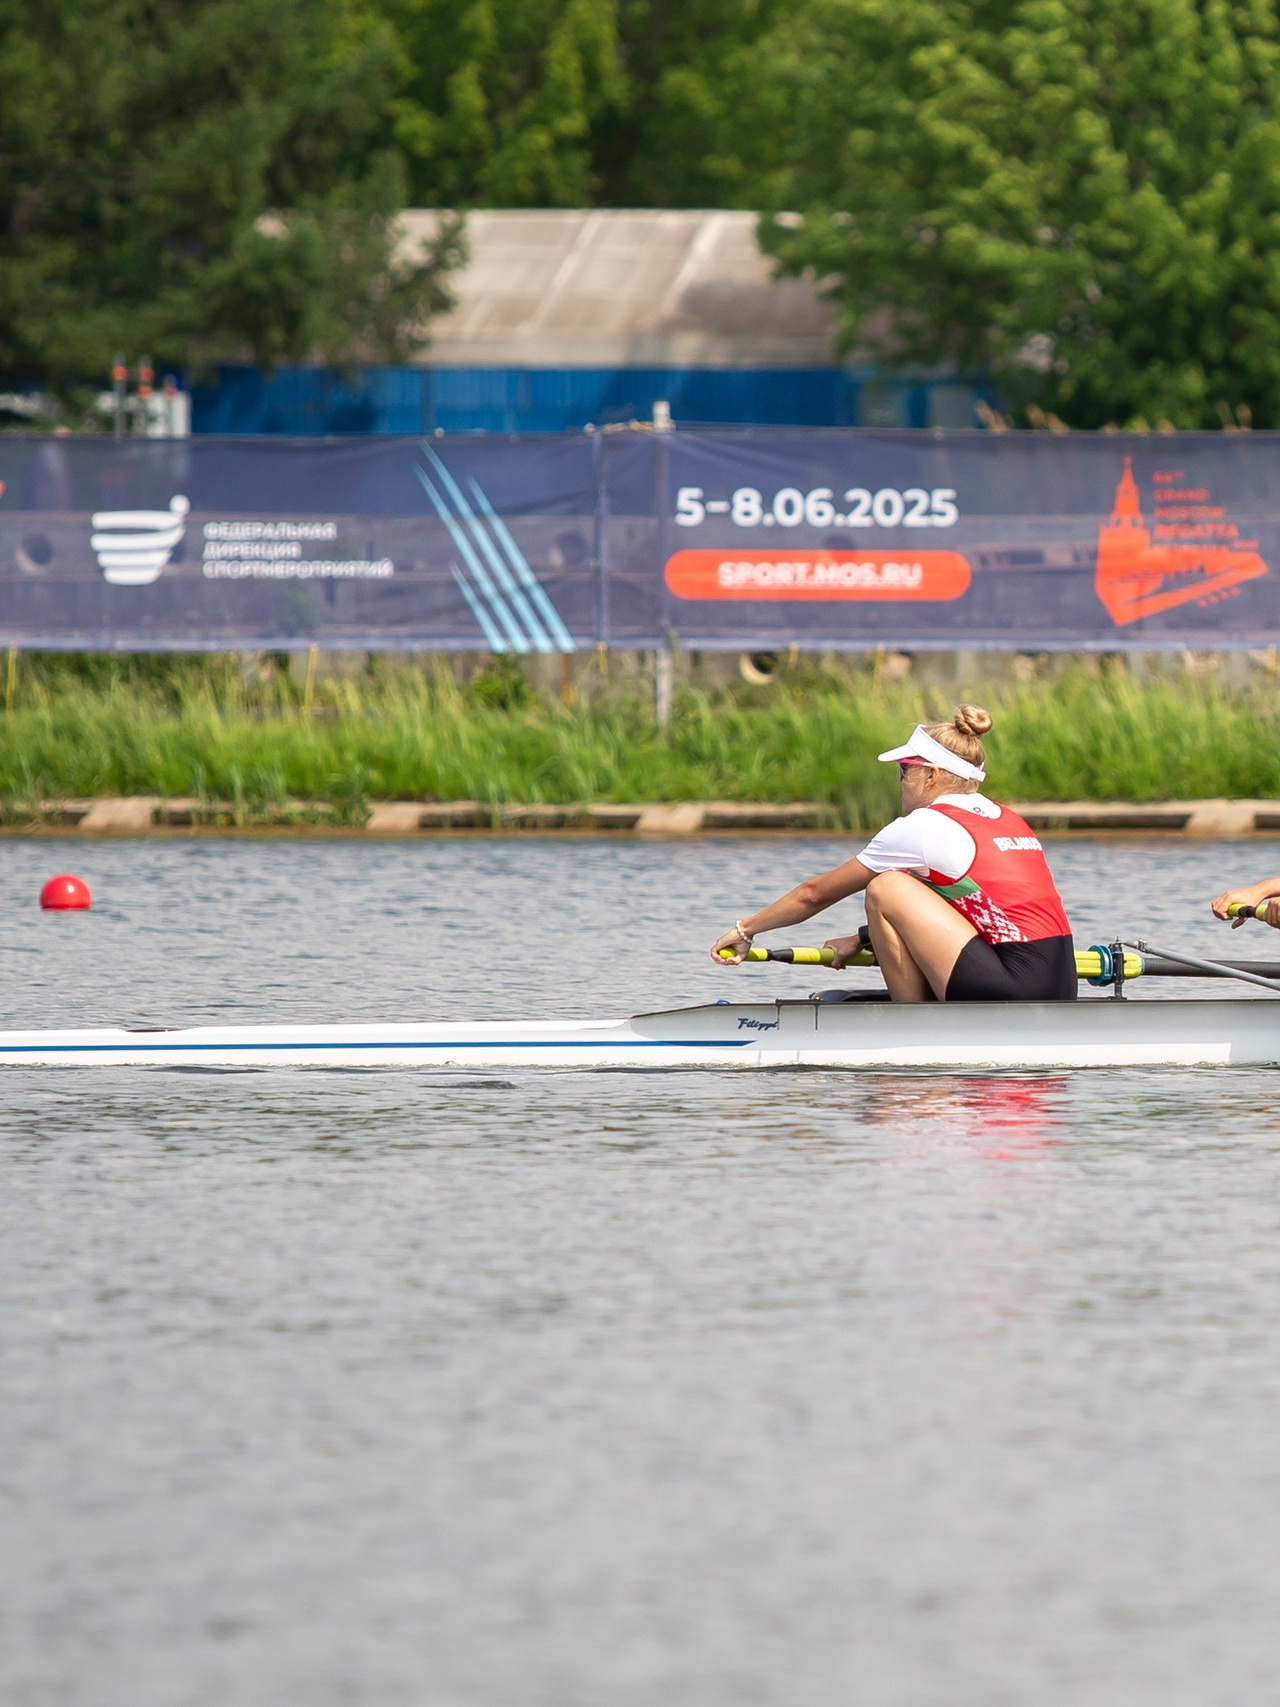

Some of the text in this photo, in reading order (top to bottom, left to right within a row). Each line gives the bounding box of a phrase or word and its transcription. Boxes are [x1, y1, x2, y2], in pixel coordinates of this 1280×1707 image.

[203, 522, 337, 541] ФЕДЕРАЛЬНАЯ
[203, 541, 302, 560] ДИРЕКЦИЯ
[717, 562, 923, 589] SPORT.MOS.RU
